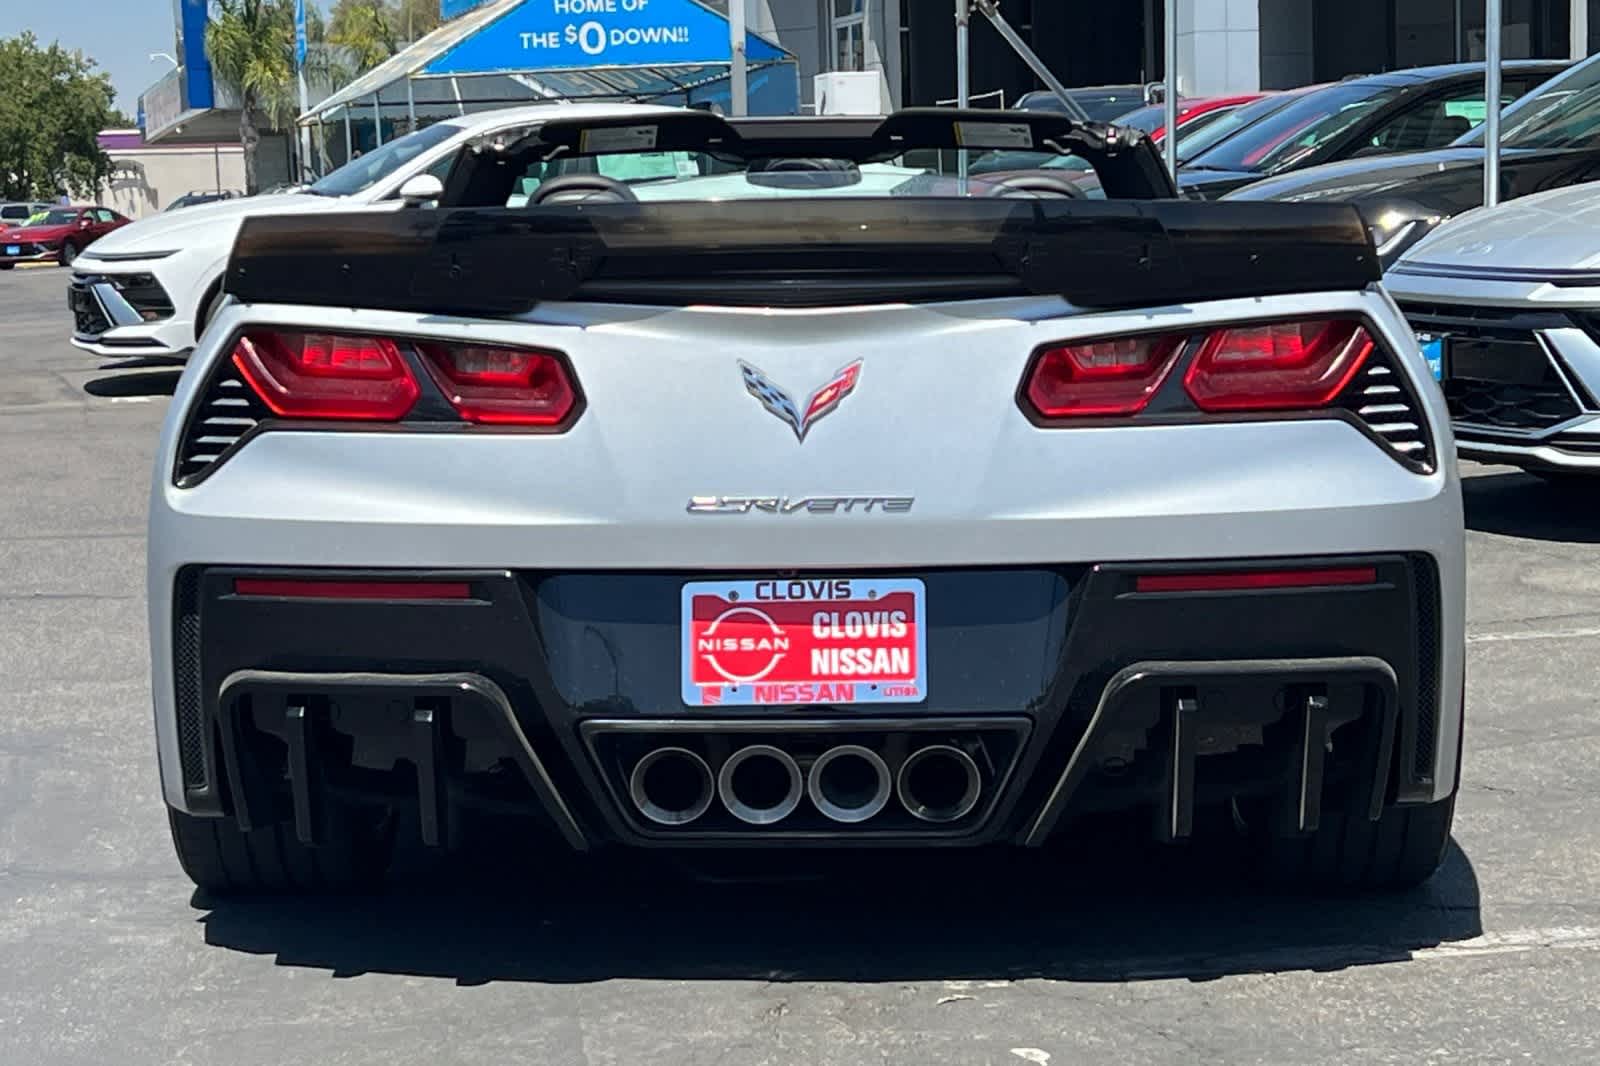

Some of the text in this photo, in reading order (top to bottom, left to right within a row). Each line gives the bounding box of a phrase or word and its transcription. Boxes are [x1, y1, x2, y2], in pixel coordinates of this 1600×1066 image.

[553, 0, 649, 14] HOME OF
[520, 32, 560, 49] THE
[609, 27, 689, 47] DOWN!!
[755, 580, 851, 600] CLOVIS
[812, 611, 907, 638] CLOVIS
[698, 638, 790, 651] NISSAN
[811, 648, 909, 675] NISSAN
[754, 684, 855, 703] NISSAN
